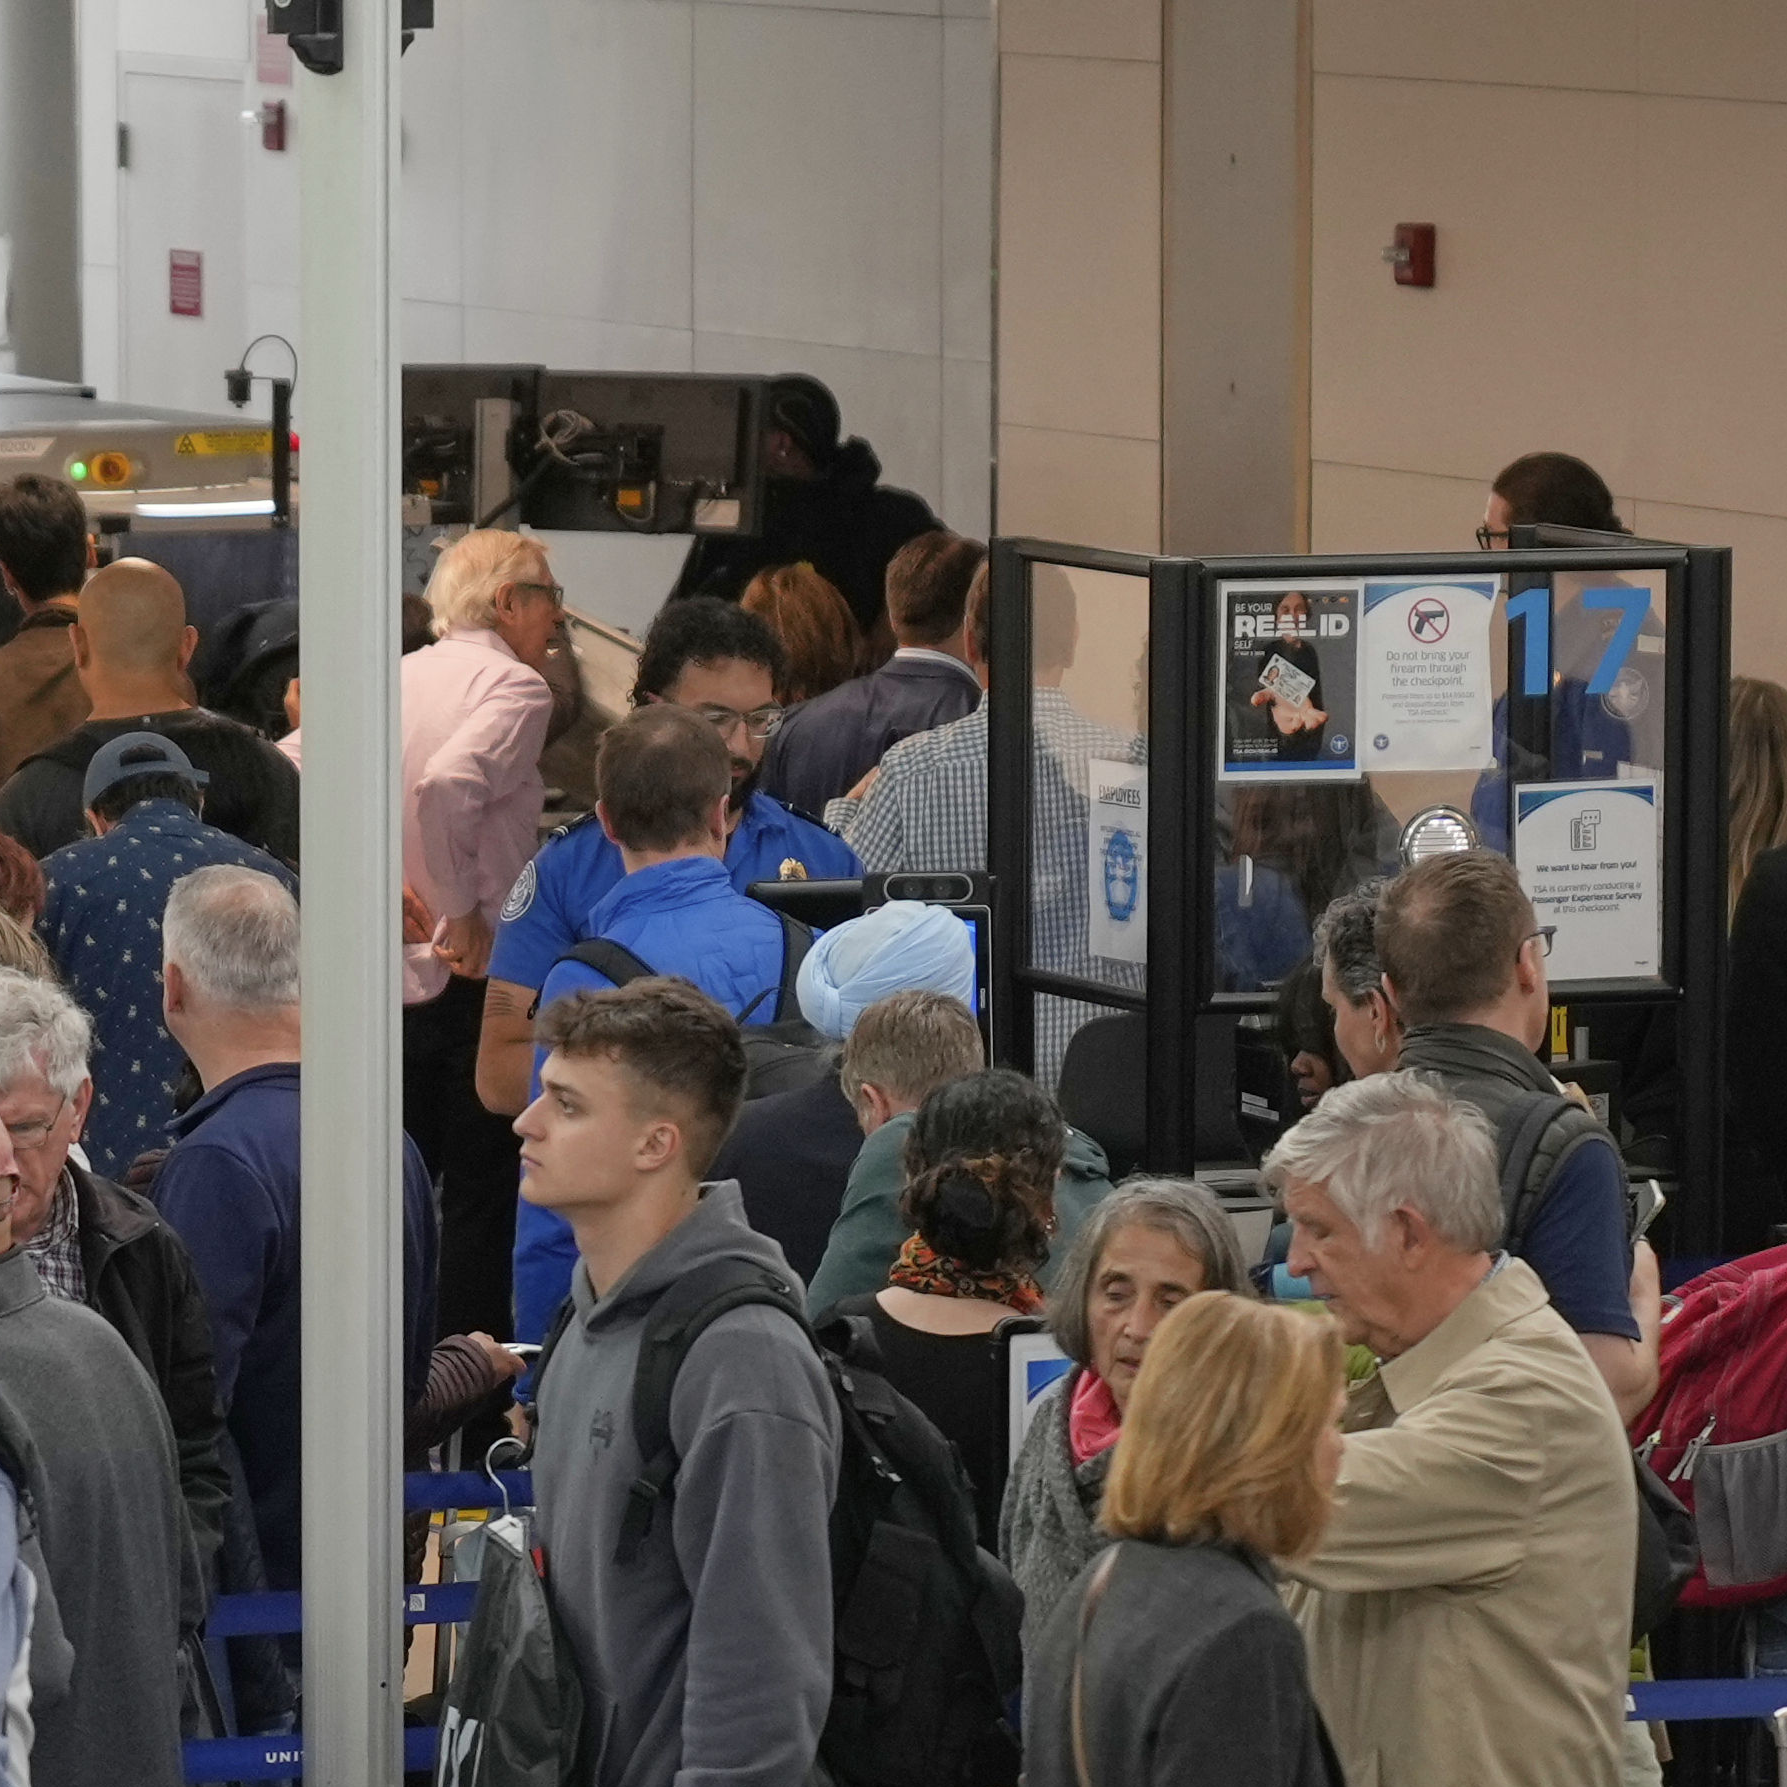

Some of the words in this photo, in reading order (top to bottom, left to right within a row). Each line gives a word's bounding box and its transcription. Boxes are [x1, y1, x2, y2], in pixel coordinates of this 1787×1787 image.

[1235, 603, 1247, 613] BE
[1248, 602, 1273, 612] YOUR
[1234, 614, 1318, 638] REAL
[1320, 613, 1350, 637] ID
[1234, 640, 1253, 650] SELF
[1504, 587, 1651, 696] 17
[1386, 651, 1400, 661] Do
[1402, 651, 1418, 661] not
[1421, 651, 1446, 663] bring
[1449, 651, 1470, 662] your
[1391, 664, 1427, 674] firearm
[1429, 663, 1466, 674] through
[1392, 676, 1408, 687] the
[1536, 864, 1549, 872] We
[1551, 863, 1570, 872] want
[1572, 863, 1579, 871] to
[1581, 862, 1598, 871] hear
[1600, 861, 1618, 870] from
[1533, 885, 1547, 893] TSA
[1557, 883, 1591, 893] currently
[1593, 881, 1634, 892] conducting
[1532, 895, 1570, 905] Passenger
[1572, 893, 1614, 903] Experience
[1615, 891, 1643, 901] Survey
[1553, 905, 1562, 914] at
[1562, 905, 1577, 913] this
